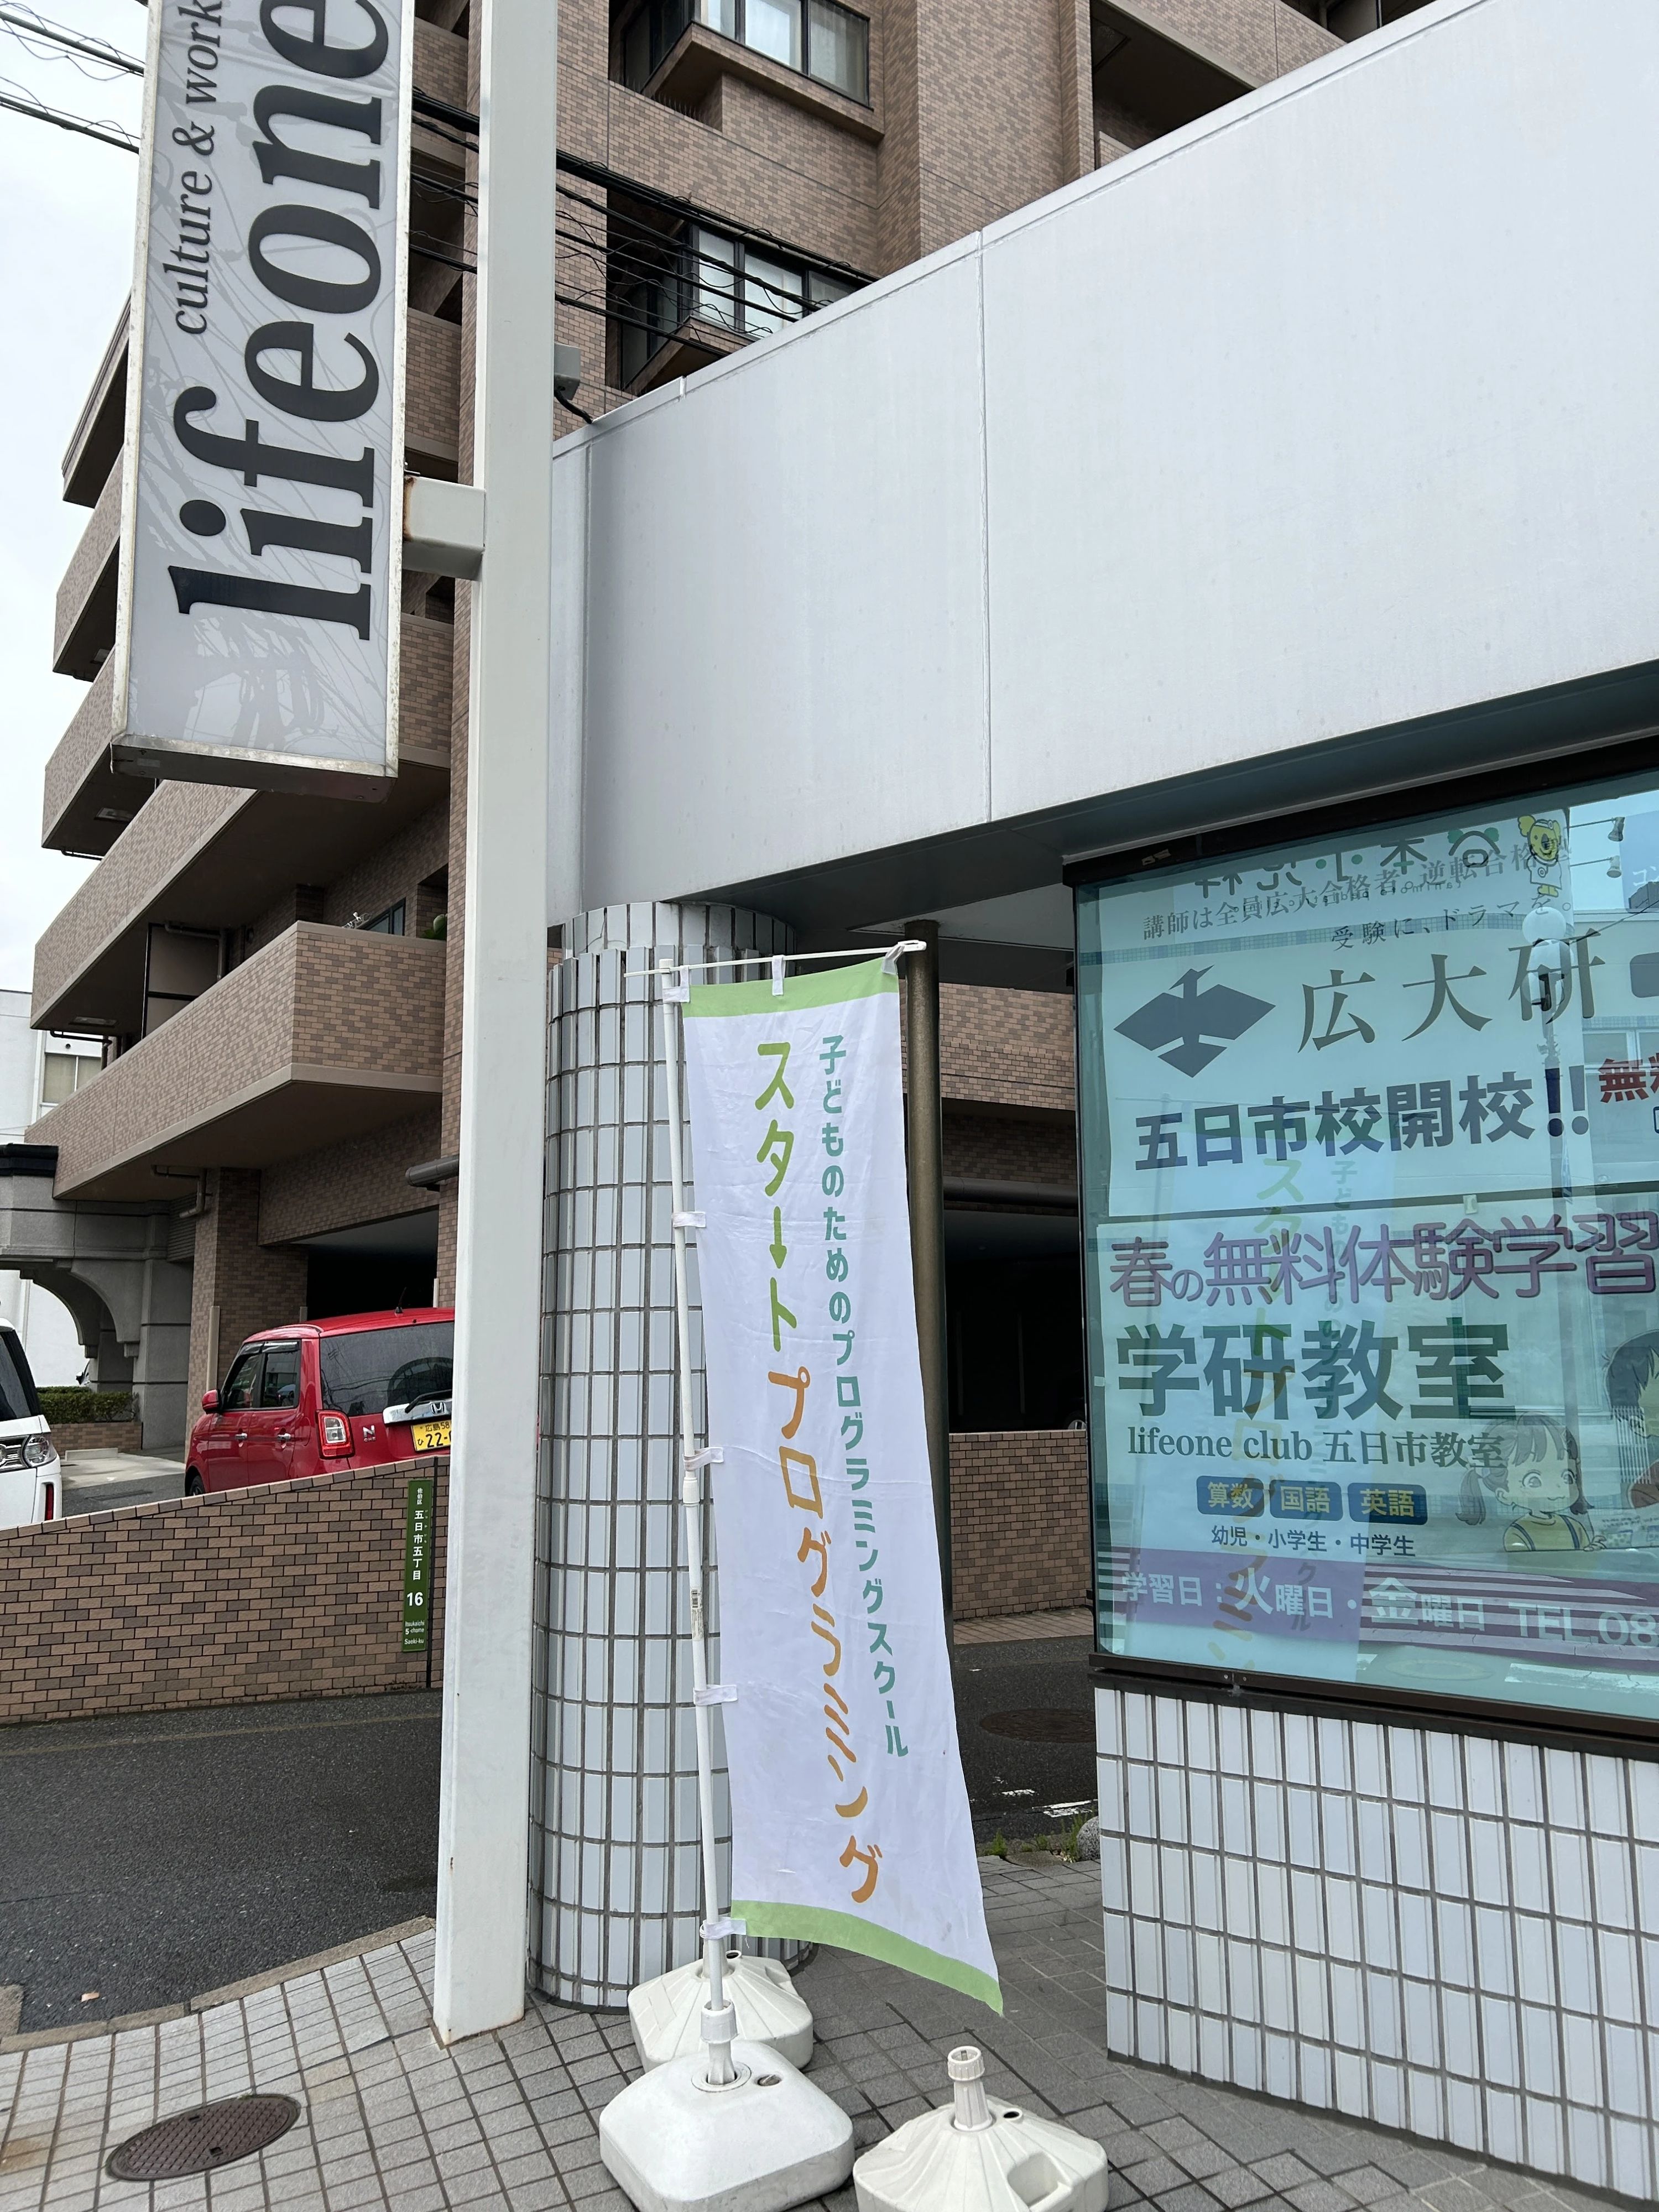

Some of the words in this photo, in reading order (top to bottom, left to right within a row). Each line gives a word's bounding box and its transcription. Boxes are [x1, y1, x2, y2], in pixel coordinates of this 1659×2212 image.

[177, 0, 222, 104] work
[172, 121, 215, 156] &
[163, 170, 213, 335] culture
[168, 0, 389, 640] lifeone
[1296, 927, 1606, 1054] 広大研
[1110, 1211, 1659, 1307] 春の無料体験学習
[819, 1035, 909, 1757] 子どものためのプログラミングスクール
[1116, 1317, 1509, 1421] 学研教室
[1128, 1426, 1233, 1457] lifeone
[1243, 1430, 1313, 1460] club
[1323, 1430, 1507, 1469] 五日市教室
[413, 1510, 424, 1580] 五日市五丁目
[1207, 1481, 1254, 1510] 算数
[1280, 1485, 1331, 1514] 国語
[1360, 1489, 1415, 1517] 英語
[1211, 1525, 1416, 1557] 幼児・小学生・中学生
[406, 1592, 424, 1606] 16
